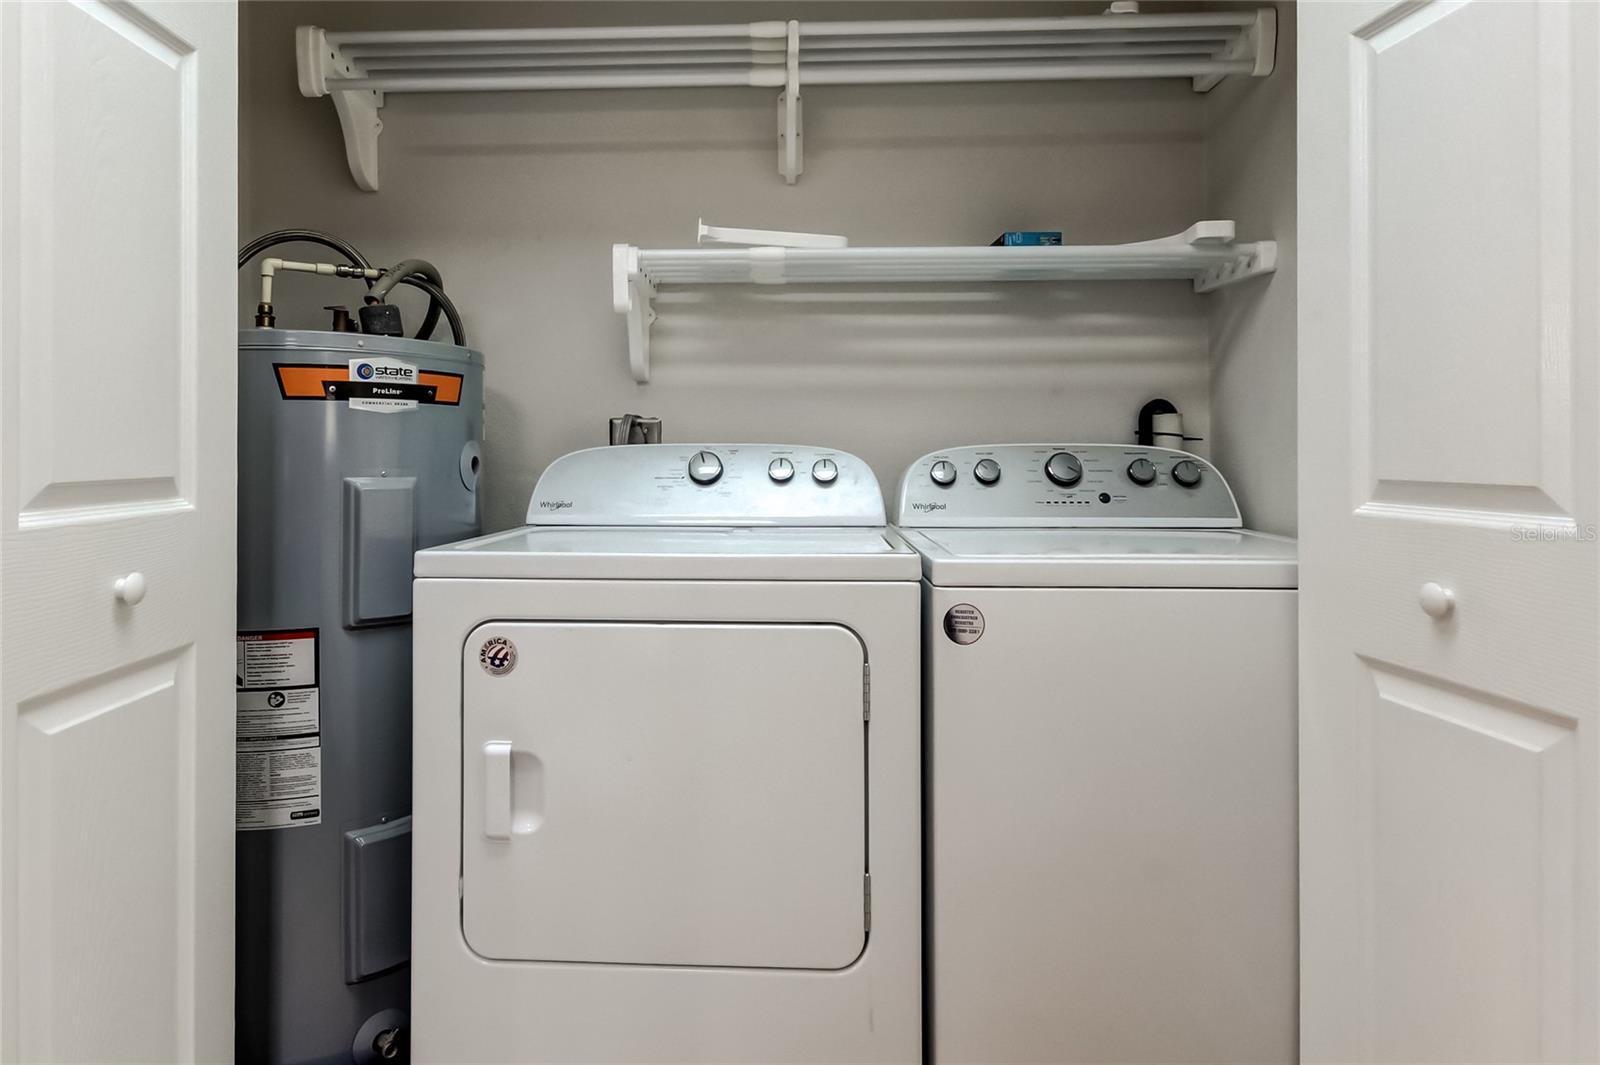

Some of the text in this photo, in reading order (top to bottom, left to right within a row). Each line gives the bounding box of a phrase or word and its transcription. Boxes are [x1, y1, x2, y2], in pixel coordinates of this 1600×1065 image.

[375, 366, 413, 377] state
[372, 387, 400, 395] ProLine
[540, 501, 573, 511] Whirlpool
[912, 502, 946, 513] Whirlpool
[480, 638, 507, 663] AMERICA
